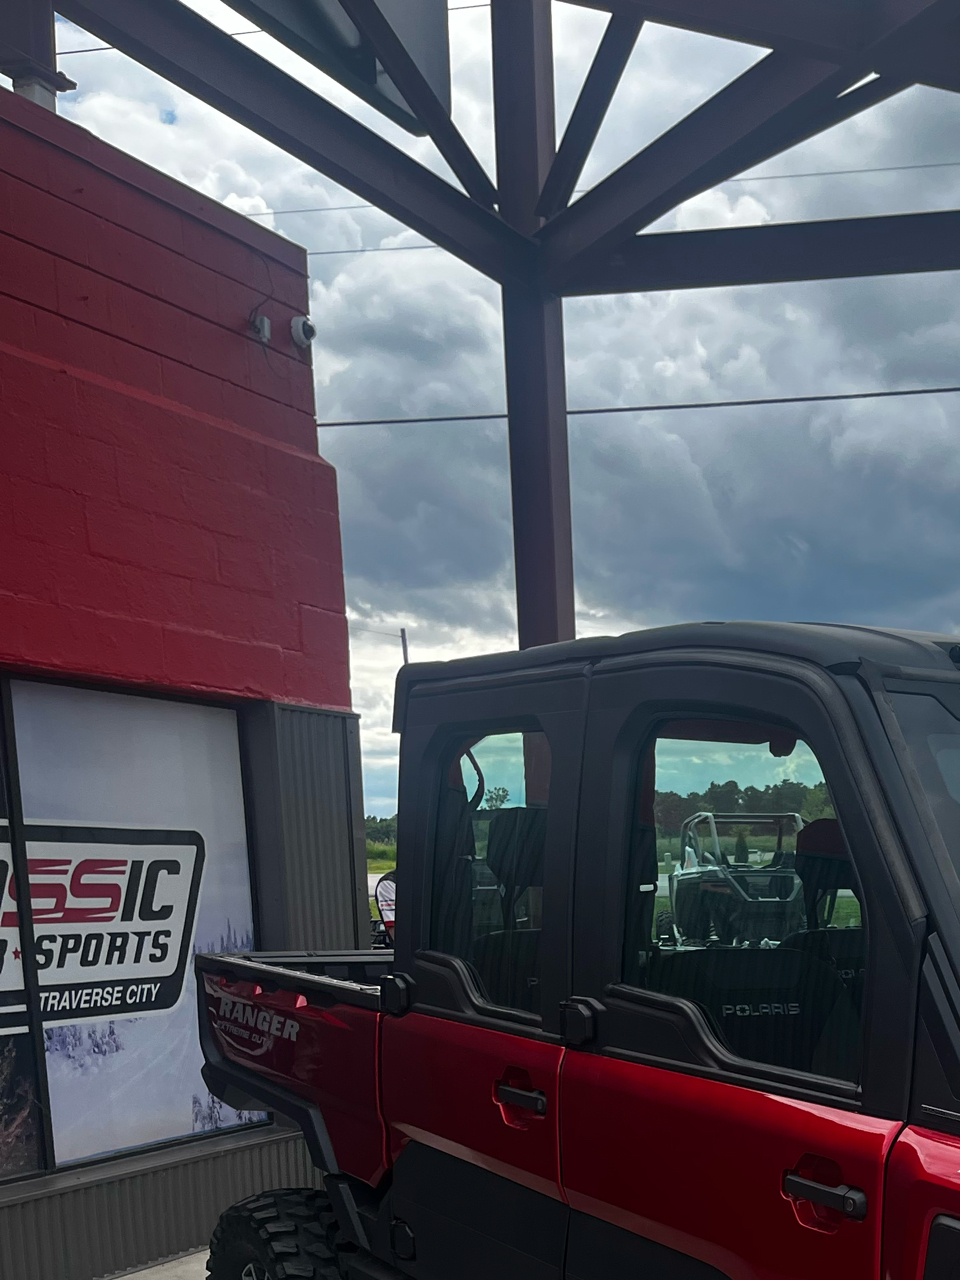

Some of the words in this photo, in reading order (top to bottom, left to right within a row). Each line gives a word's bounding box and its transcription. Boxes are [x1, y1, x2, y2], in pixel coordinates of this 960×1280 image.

[0, 858, 181, 928] SSIC
[36, 929, 172, 971] SPORTS
[39, 985, 122, 1012] TRAVERSE
[125, 982, 161, 1004] CITY
[721, 1003, 801, 1017] POLARIS
[219, 998, 300, 1042] RANGER
